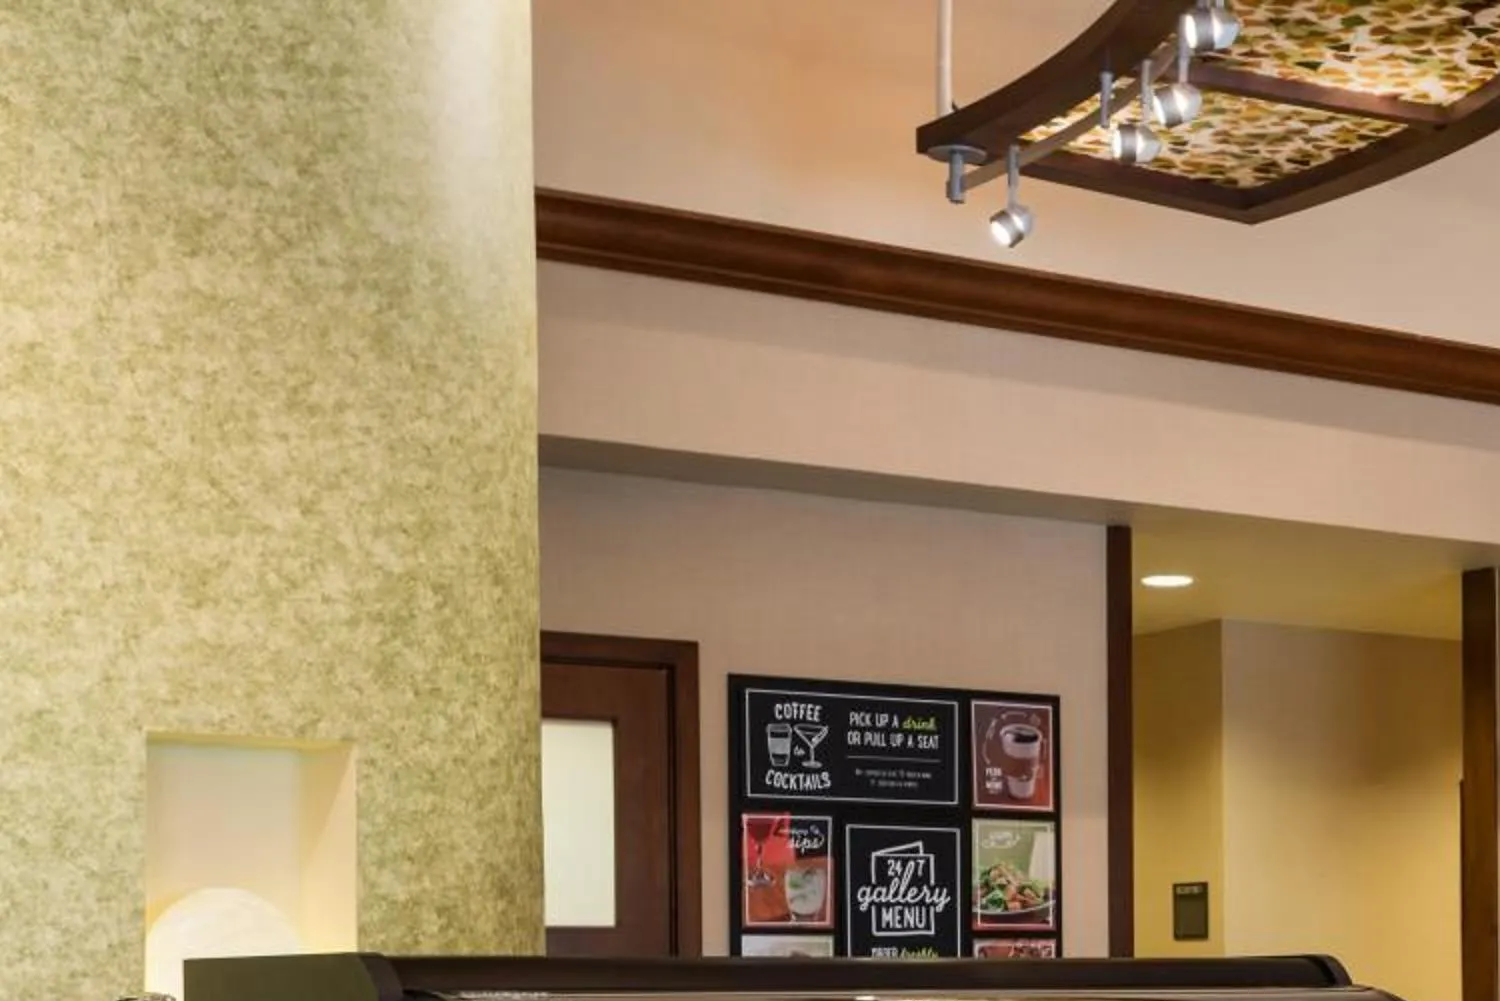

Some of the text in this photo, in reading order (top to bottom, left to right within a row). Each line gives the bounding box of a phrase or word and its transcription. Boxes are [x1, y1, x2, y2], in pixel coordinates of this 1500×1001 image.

[774, 702, 822, 722] COFFEE
[849, 711, 937, 731] PICK UP A drink
[847, 730, 939, 750] OR PULL UP A SEAT
[765, 769, 831, 791] COCKTAILS
[857, 860, 951, 912] gallery
[881, 905, 926, 929] MENU
